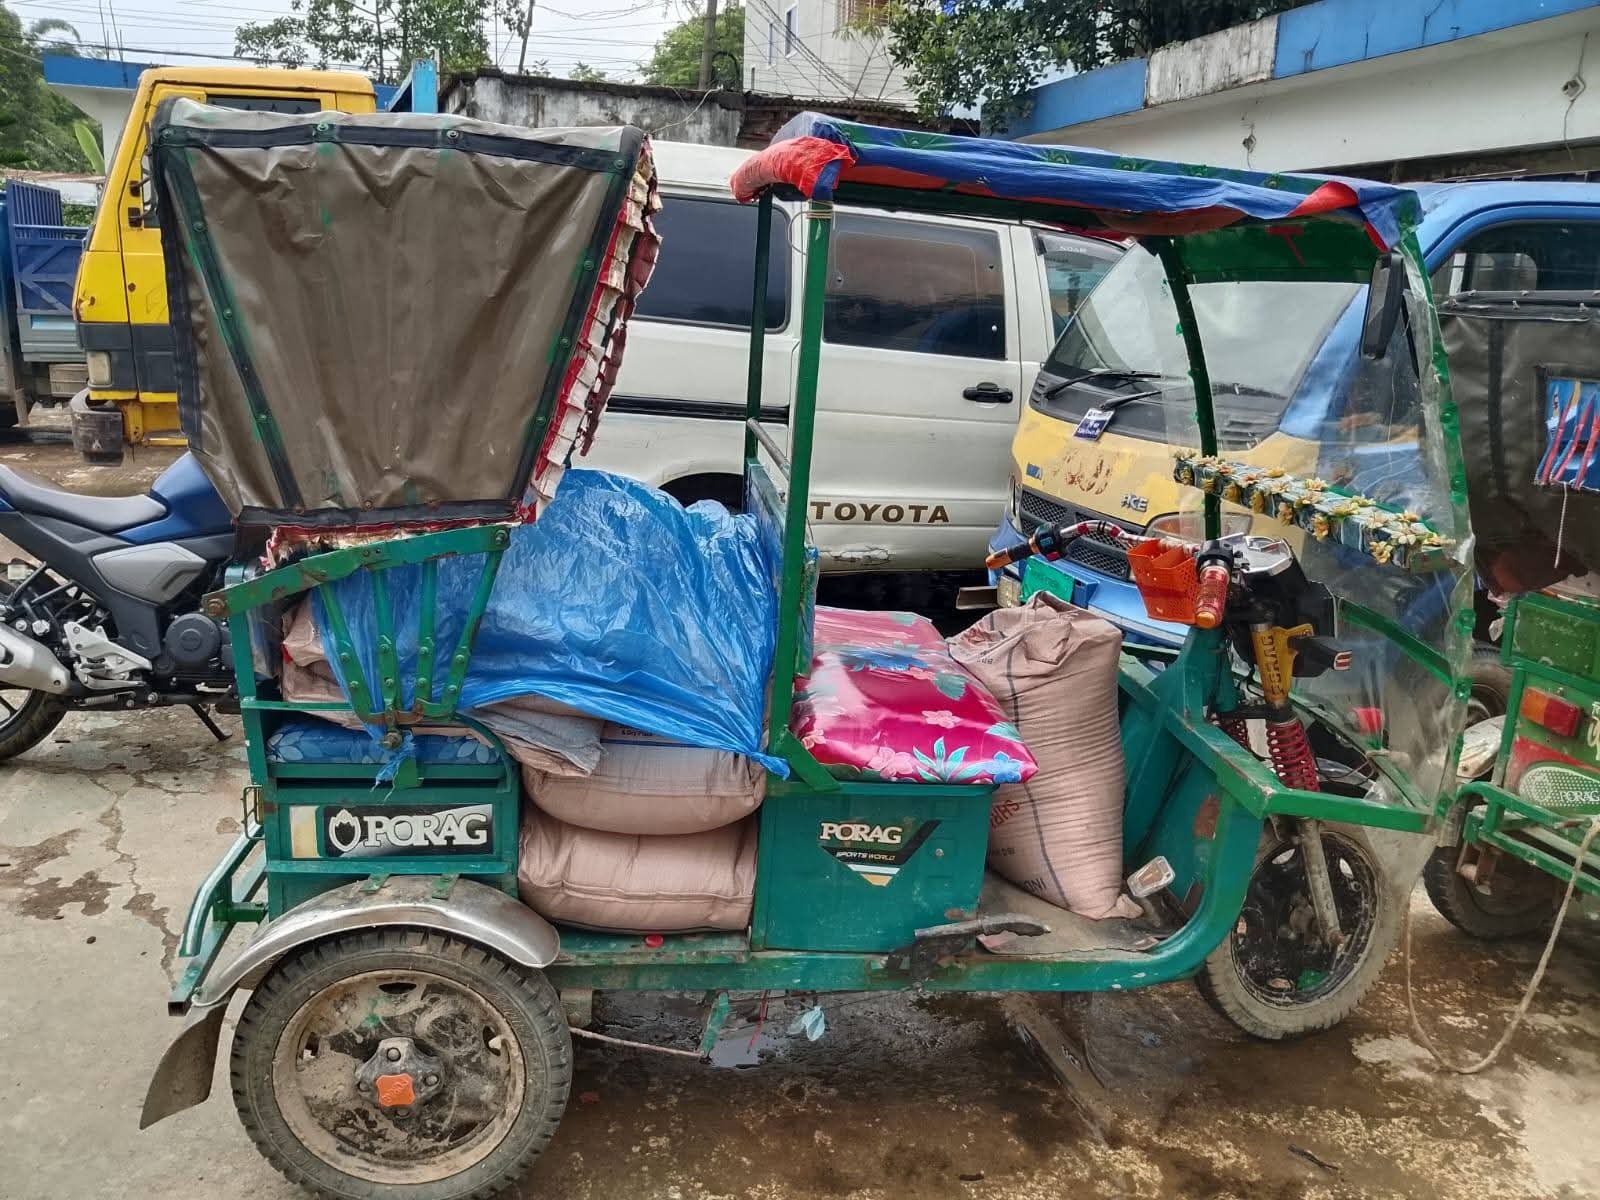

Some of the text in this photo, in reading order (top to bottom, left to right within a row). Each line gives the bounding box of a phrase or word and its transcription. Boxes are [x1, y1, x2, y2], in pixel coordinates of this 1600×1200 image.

[810, 501, 949, 523] TOYOTA
[363, 813, 488, 848] PORAG
[820, 822, 903, 844] PORAG
[868, 853, 896, 861] WORLD
